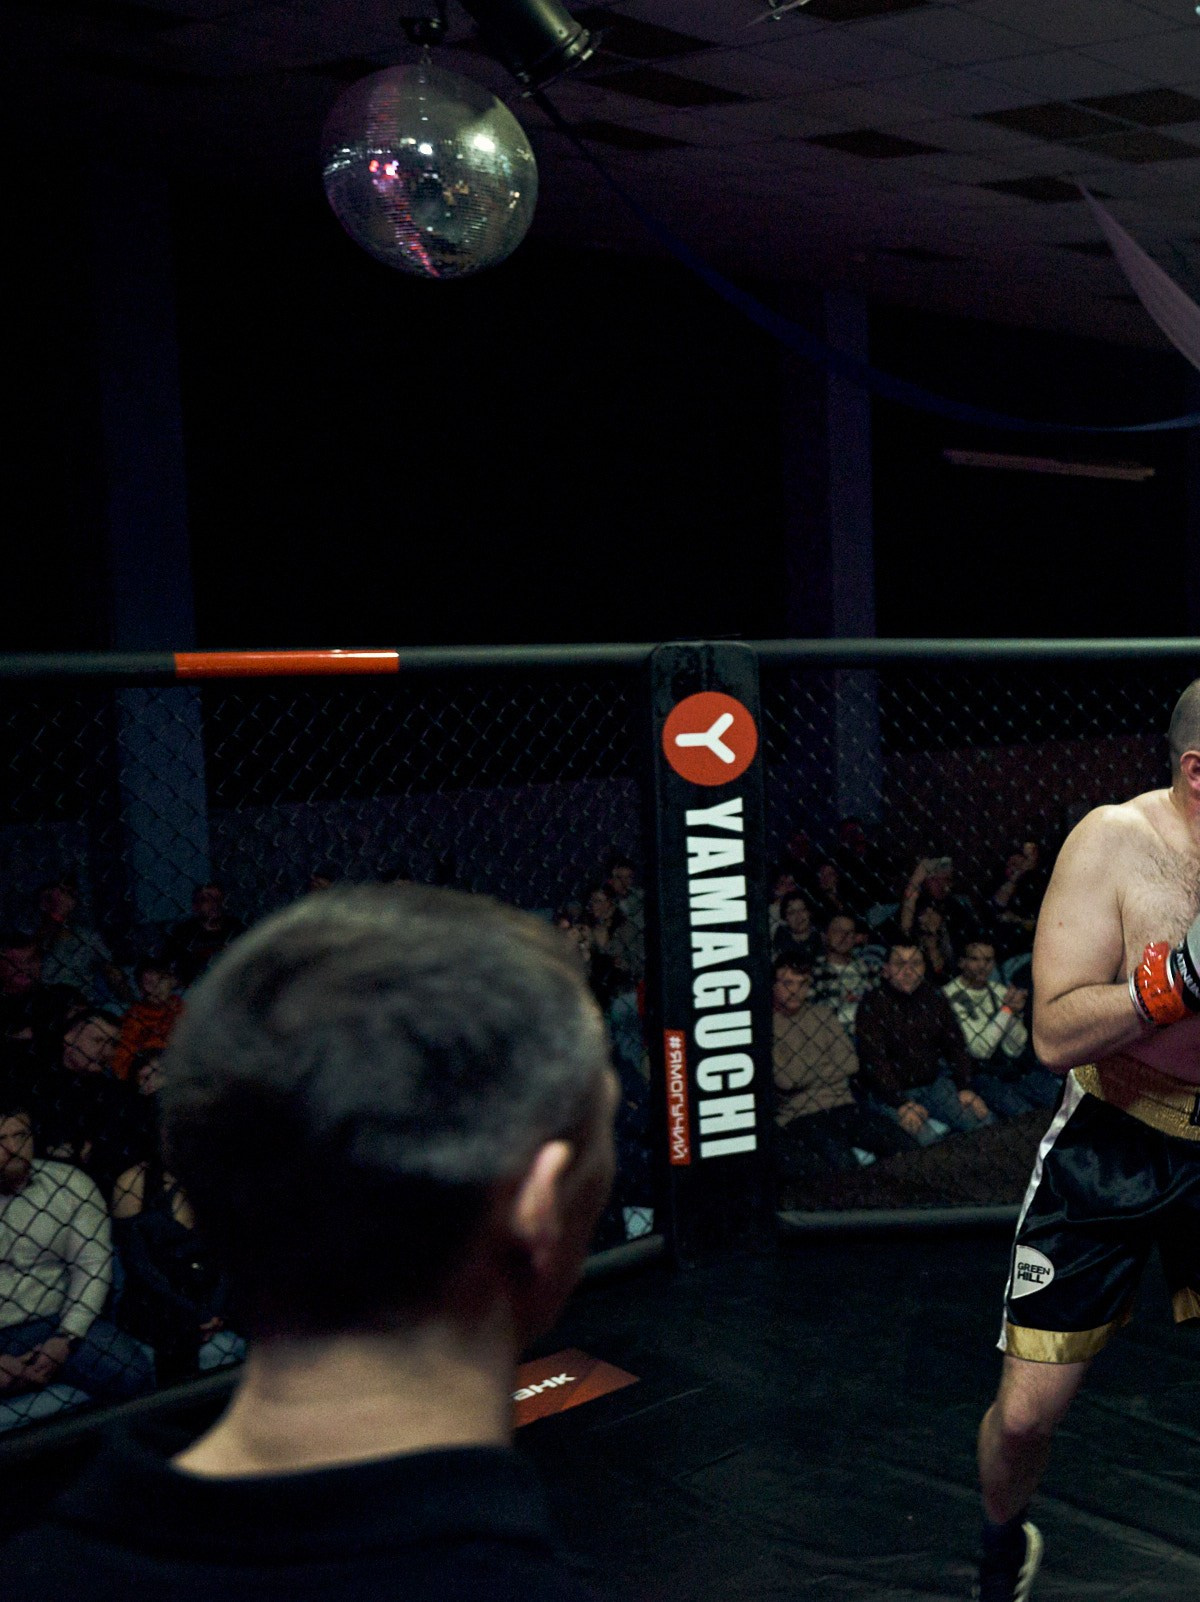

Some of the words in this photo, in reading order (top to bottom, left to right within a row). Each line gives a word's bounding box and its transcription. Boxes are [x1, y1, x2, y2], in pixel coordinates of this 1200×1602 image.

[685, 797, 757, 1158] YAMAGUCHI
[669, 1036, 689, 1160] #ЯМОГУЧИЙ
[1017, 1262, 1050, 1275] GREEN
[1017, 1270, 1044, 1284] HILL
[511, 1372, 577, 1402] анк
